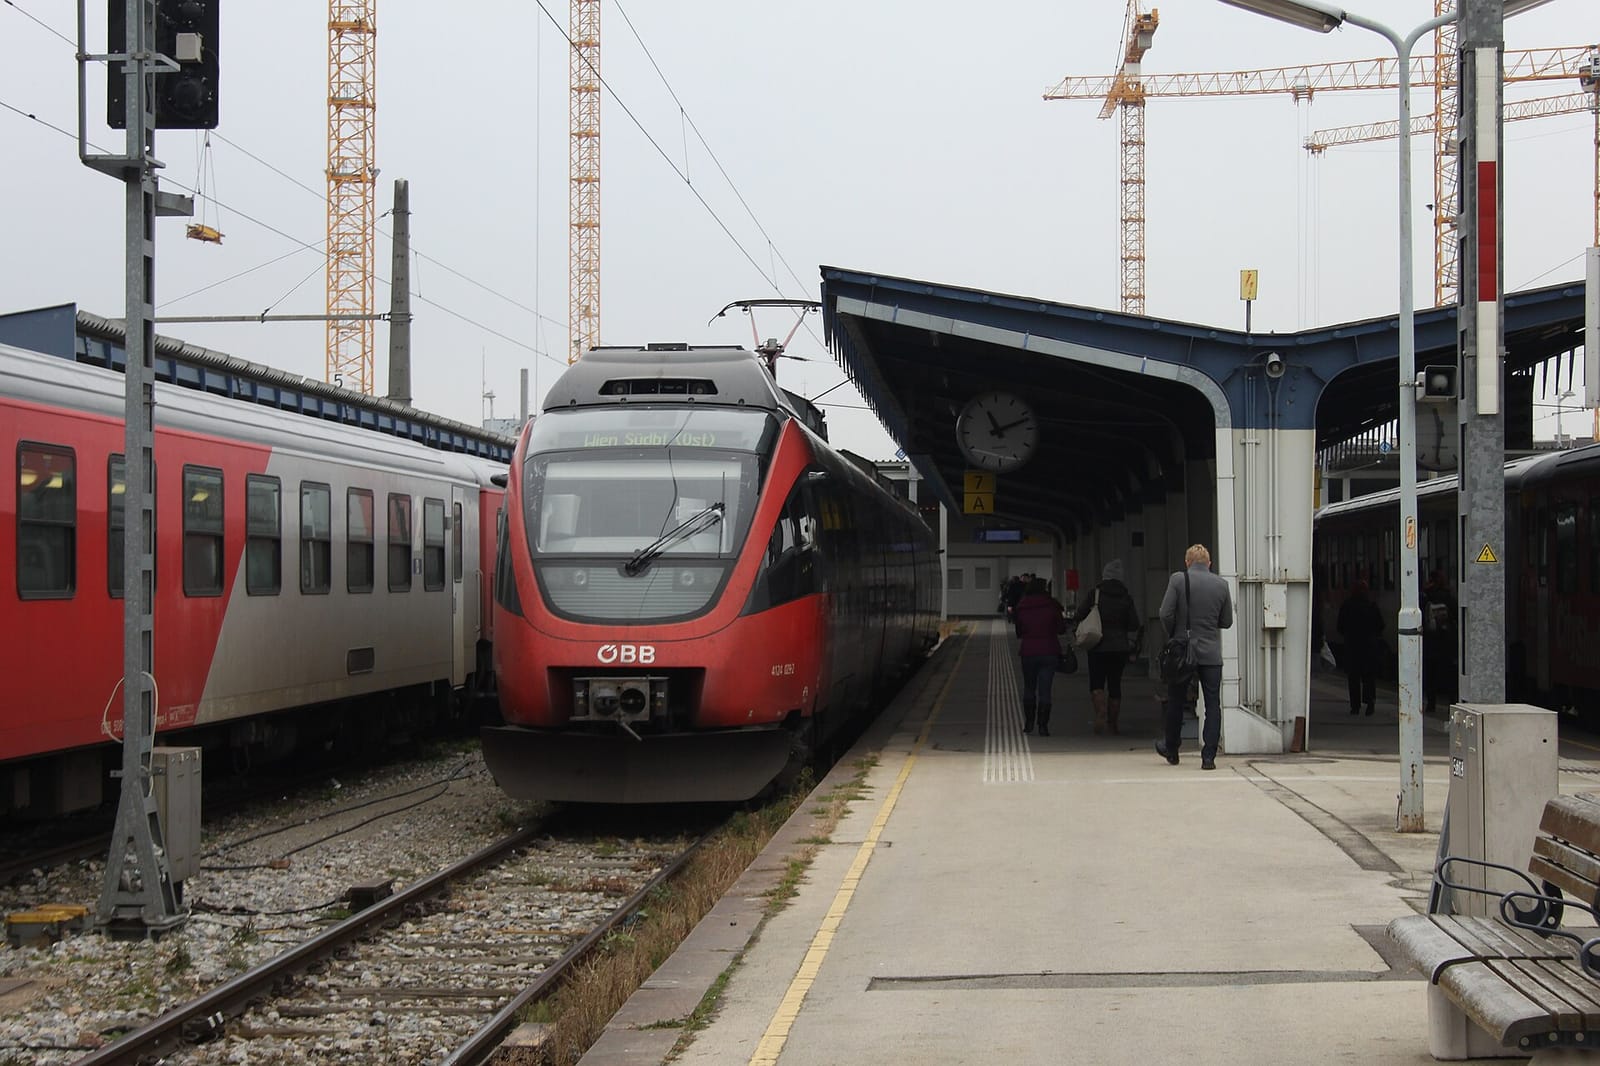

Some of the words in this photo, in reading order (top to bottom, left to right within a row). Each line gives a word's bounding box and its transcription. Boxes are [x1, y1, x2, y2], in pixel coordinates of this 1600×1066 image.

[334, 373, 343, 388] 5
[584, 433, 618, 447] Wien
[675, 432, 716, 447] (Ost)
[973, 475, 984, 490] 7
[972, 495, 985, 511] A
[597, 644, 656, 664] ÖBB
